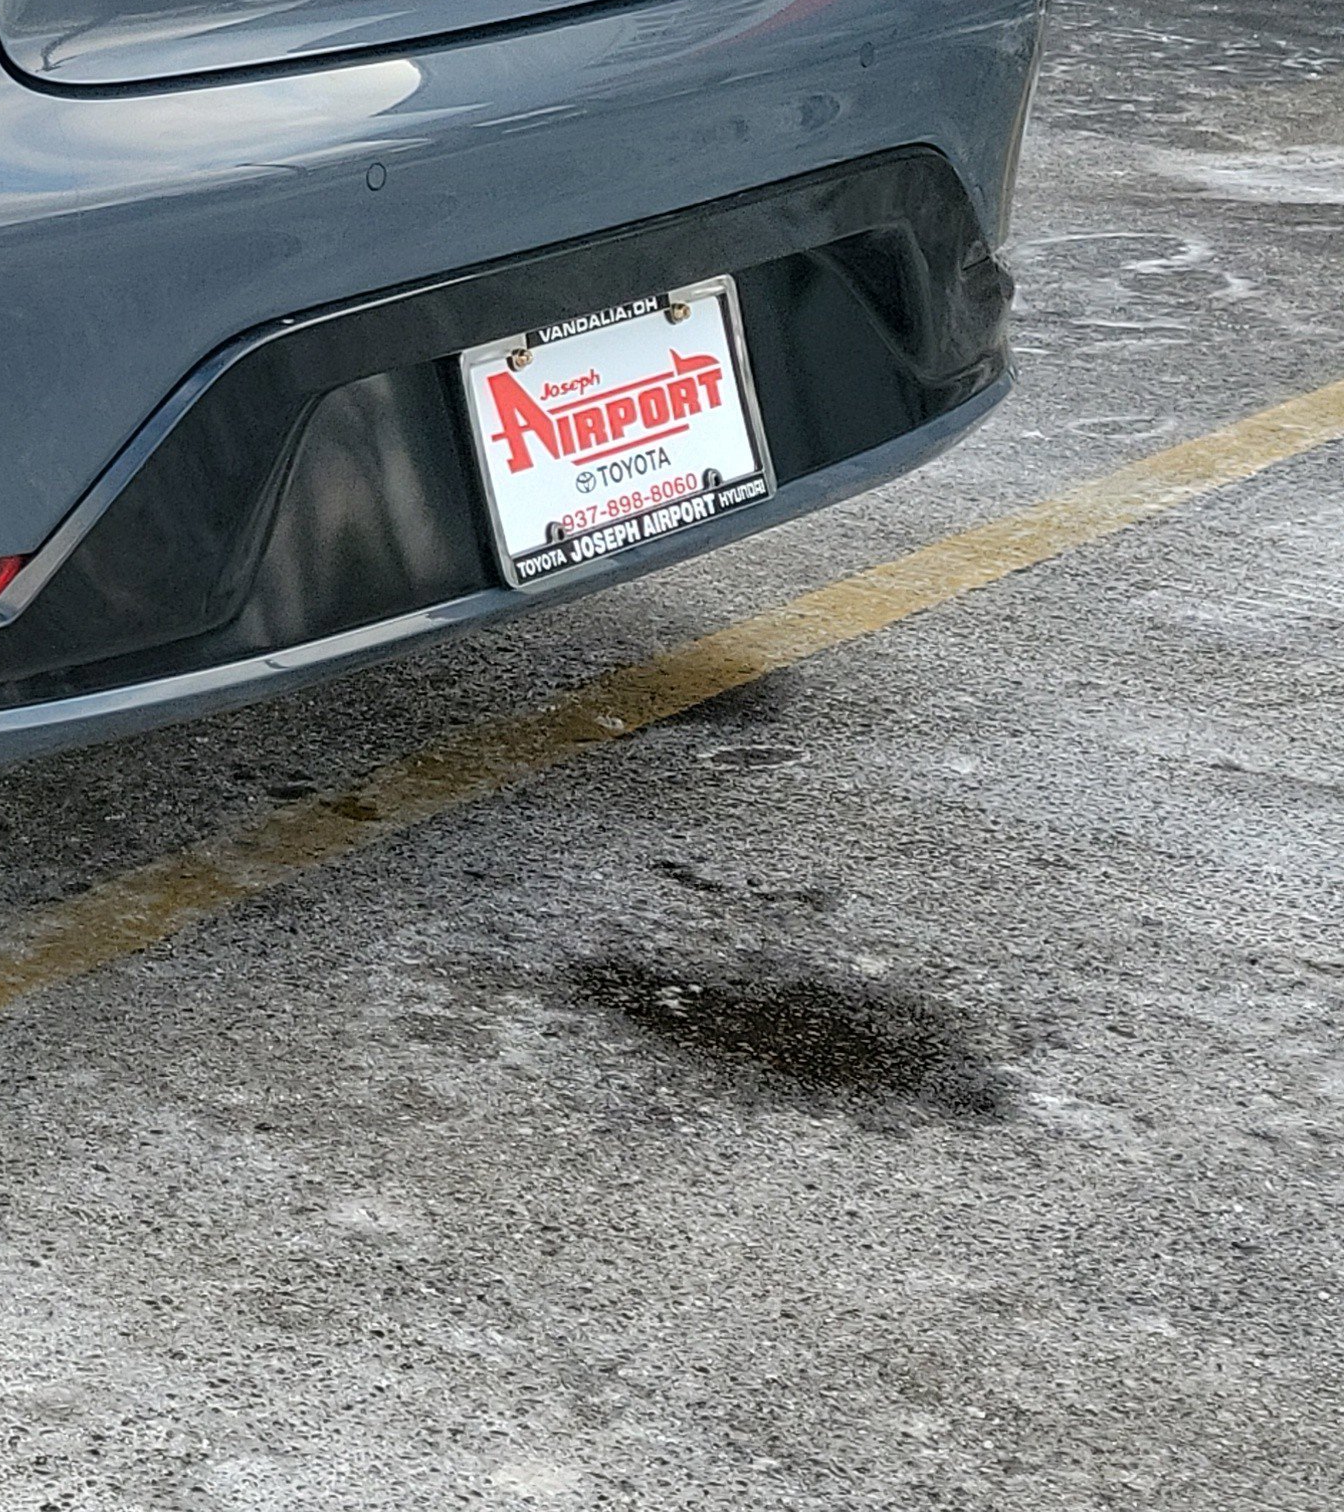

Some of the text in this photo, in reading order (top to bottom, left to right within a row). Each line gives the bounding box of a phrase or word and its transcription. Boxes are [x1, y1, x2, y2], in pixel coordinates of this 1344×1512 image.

[540, 369, 601, 401] Joseph
[596, 446, 672, 487] TOYOTA
[562, 472, 698, 533] 937-898-8060
[516, 479, 767, 579] TOYOTA JOSEPH AIRPORT HYUNDAI
